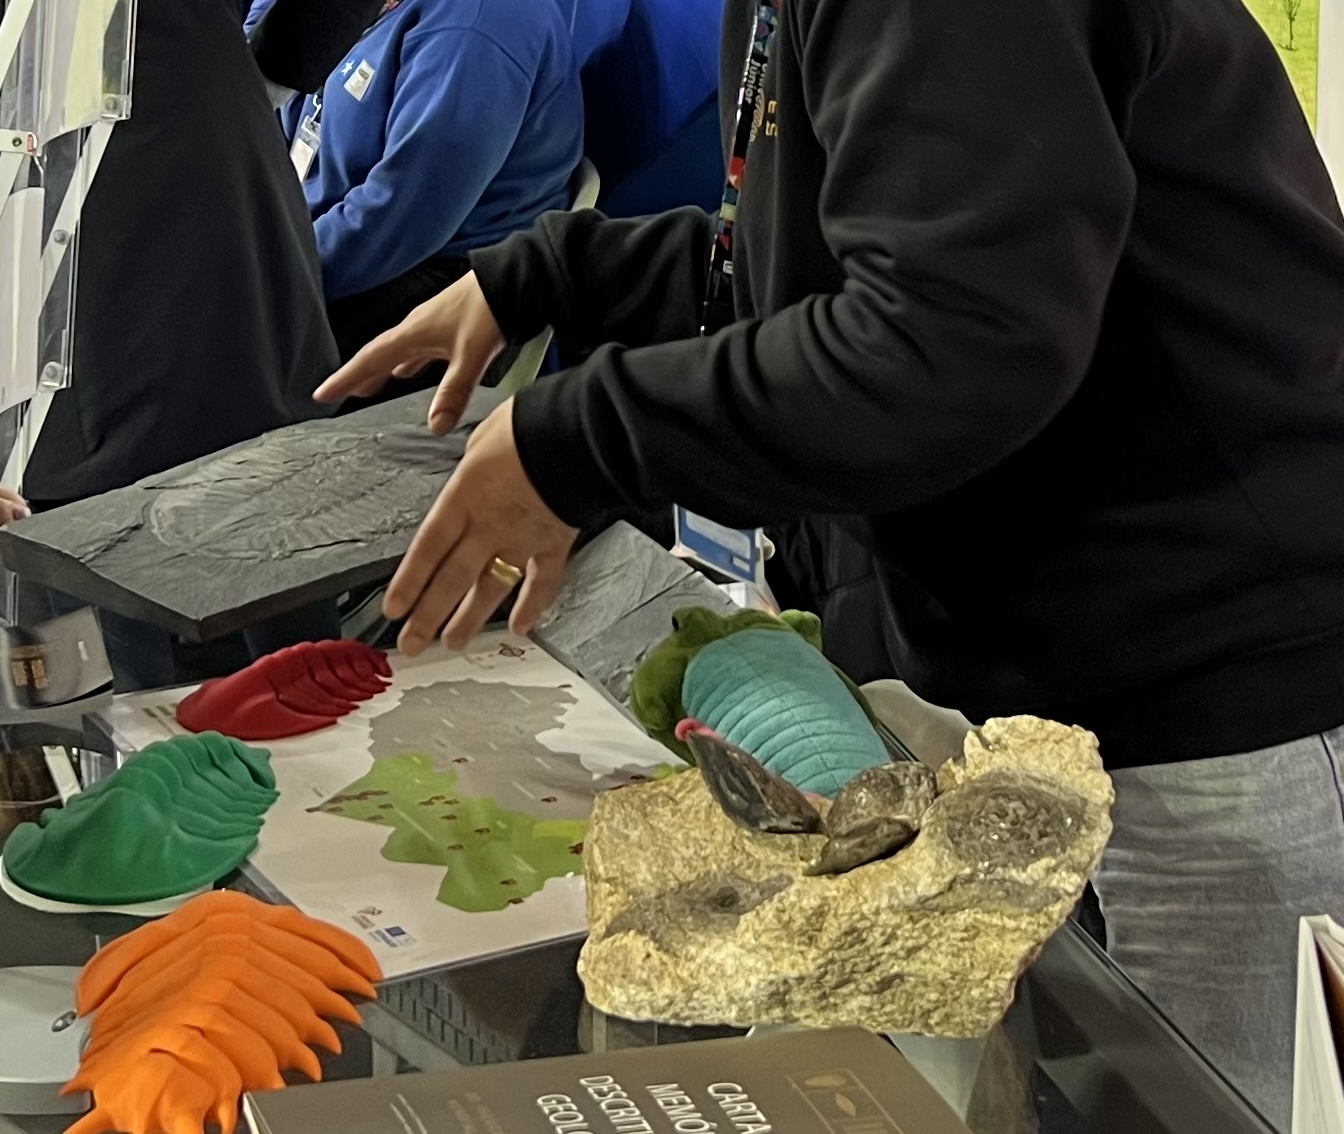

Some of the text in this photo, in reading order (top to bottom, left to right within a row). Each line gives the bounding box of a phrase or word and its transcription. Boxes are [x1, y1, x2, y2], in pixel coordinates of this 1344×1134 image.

[536, 1094, 594, 1134] GEOL
[645, 1083, 718, 1134] MEMÓ
[707, 1082, 773, 1134] CARTA
